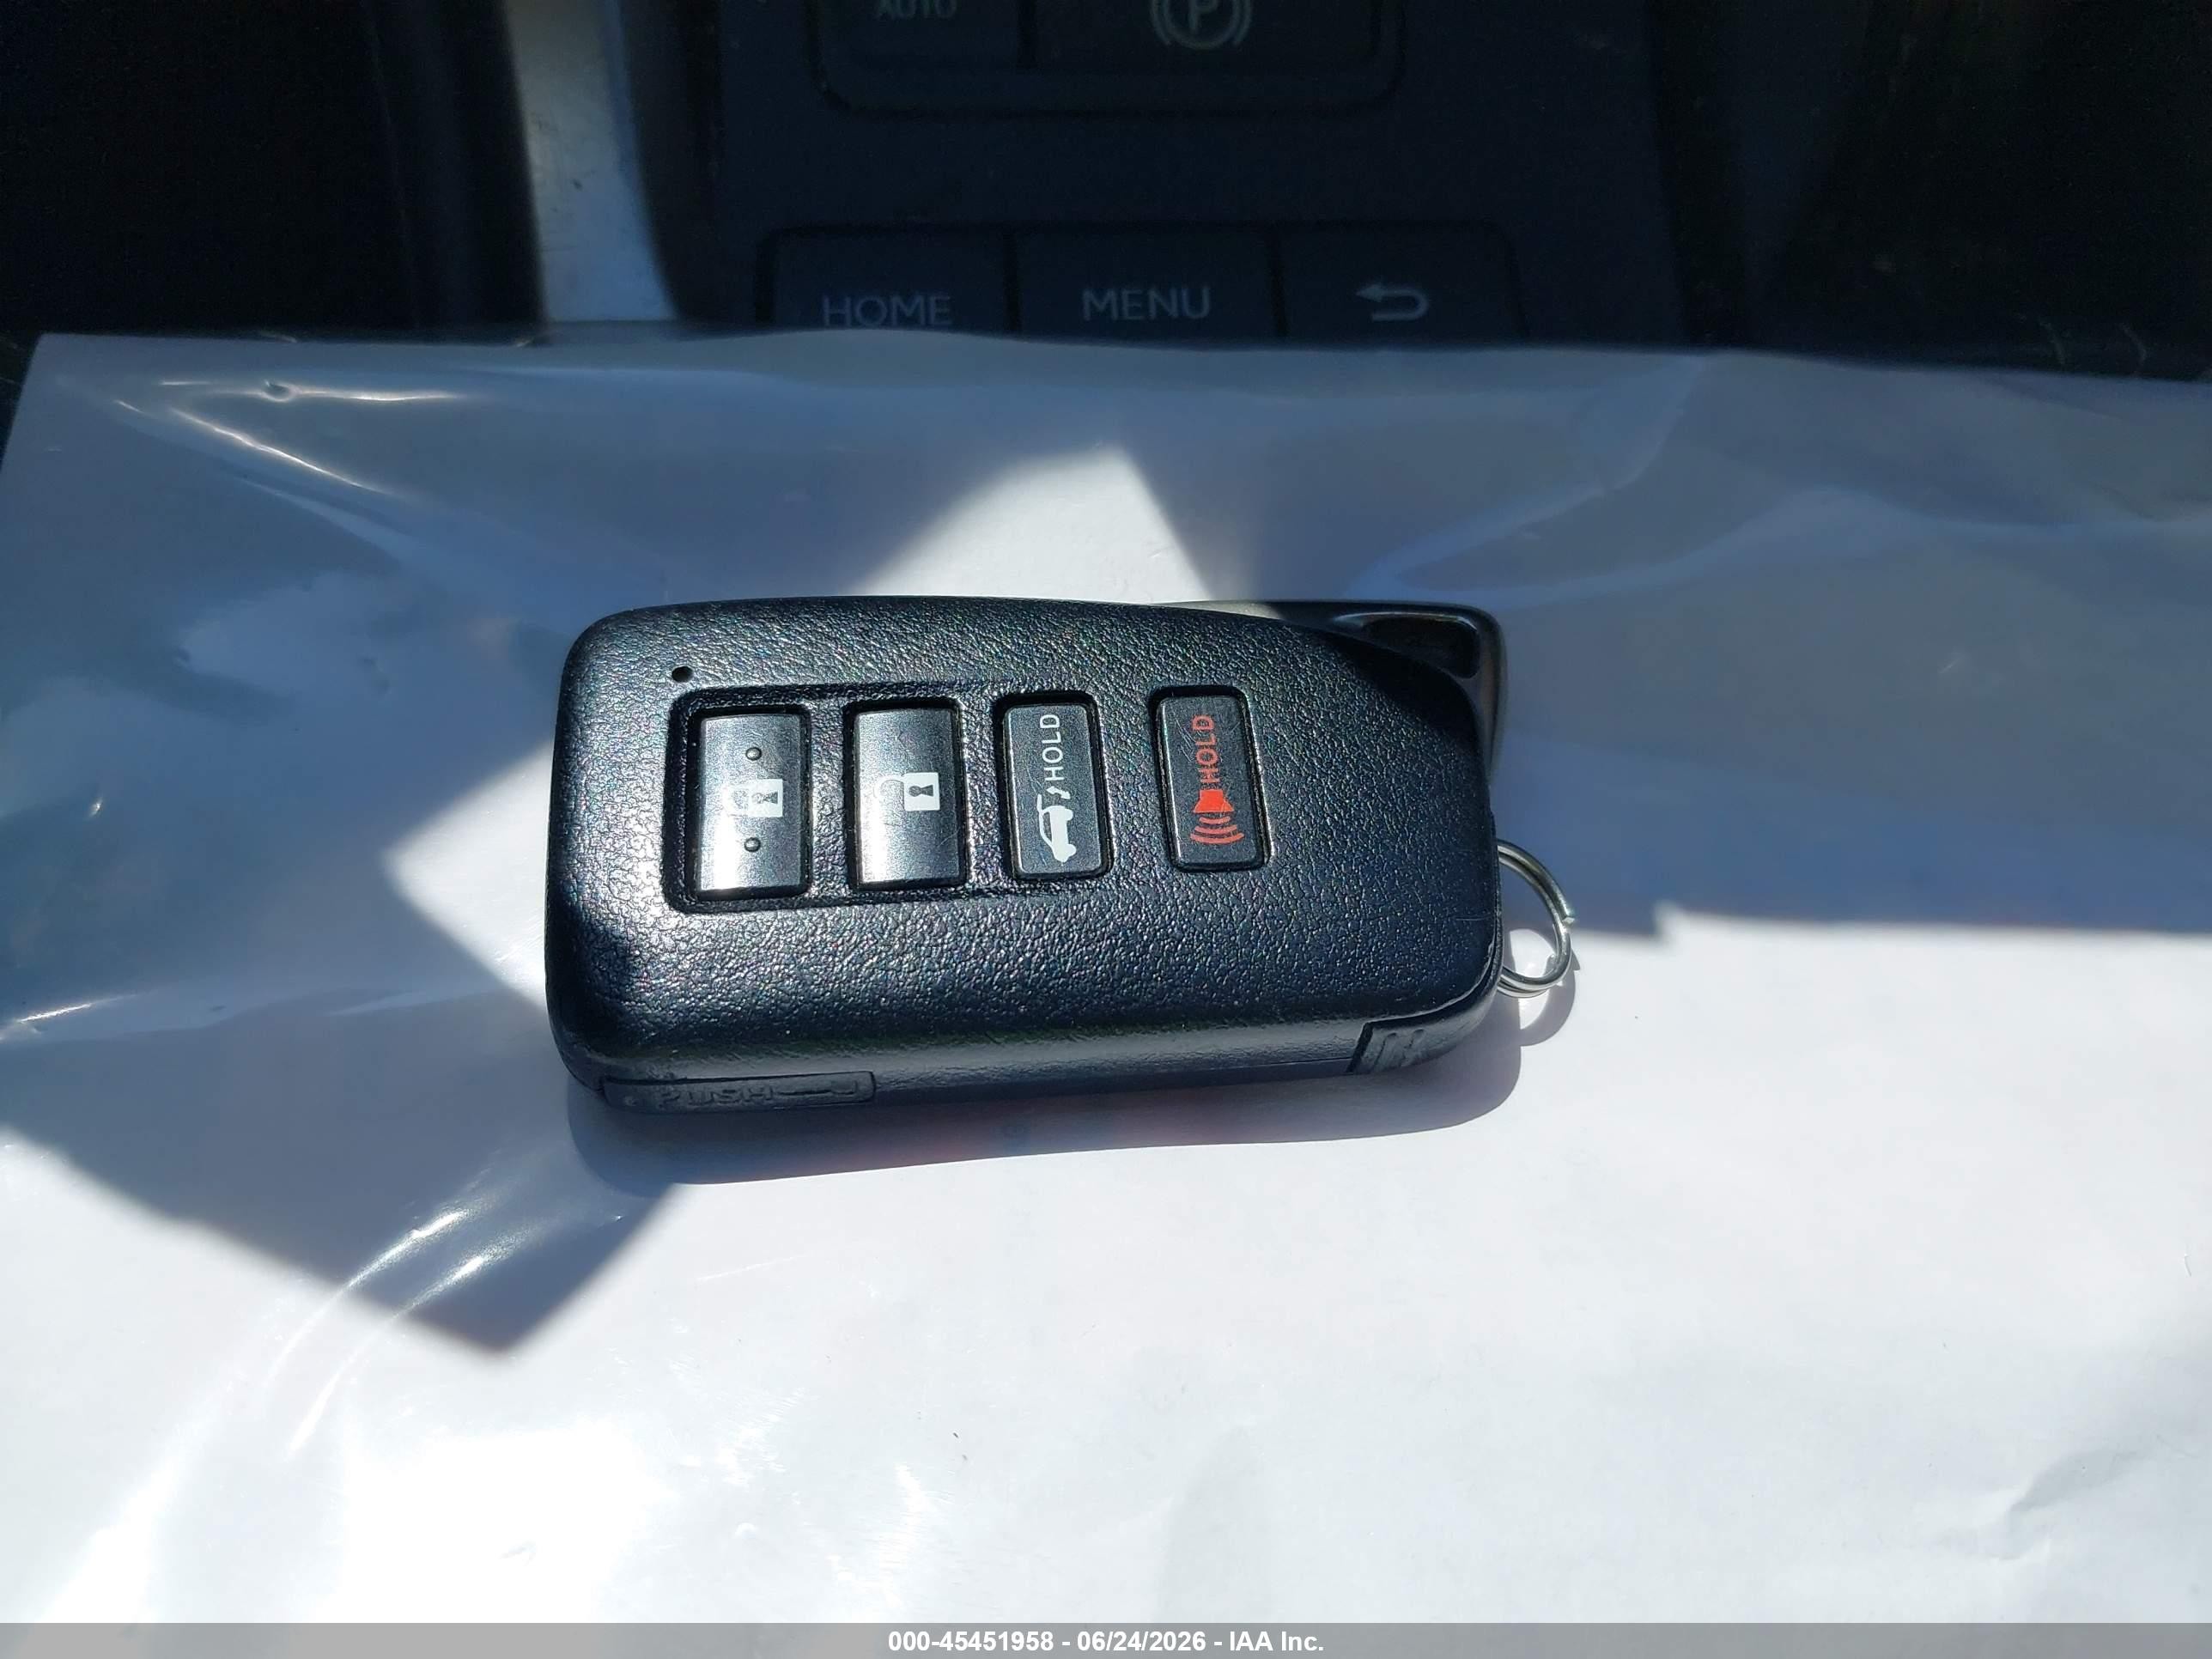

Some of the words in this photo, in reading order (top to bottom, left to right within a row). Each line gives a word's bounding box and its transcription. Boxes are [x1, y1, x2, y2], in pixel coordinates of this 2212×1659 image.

[873, 0, 957, 19] AUTO
[821, 294, 953, 327] HOME
[1080, 284, 1212, 323] MENU
[1039, 714, 1064, 782] HOLD
[1190, 714, 1221, 784] HOLD
[659, 1085, 773, 1109] PUSH
